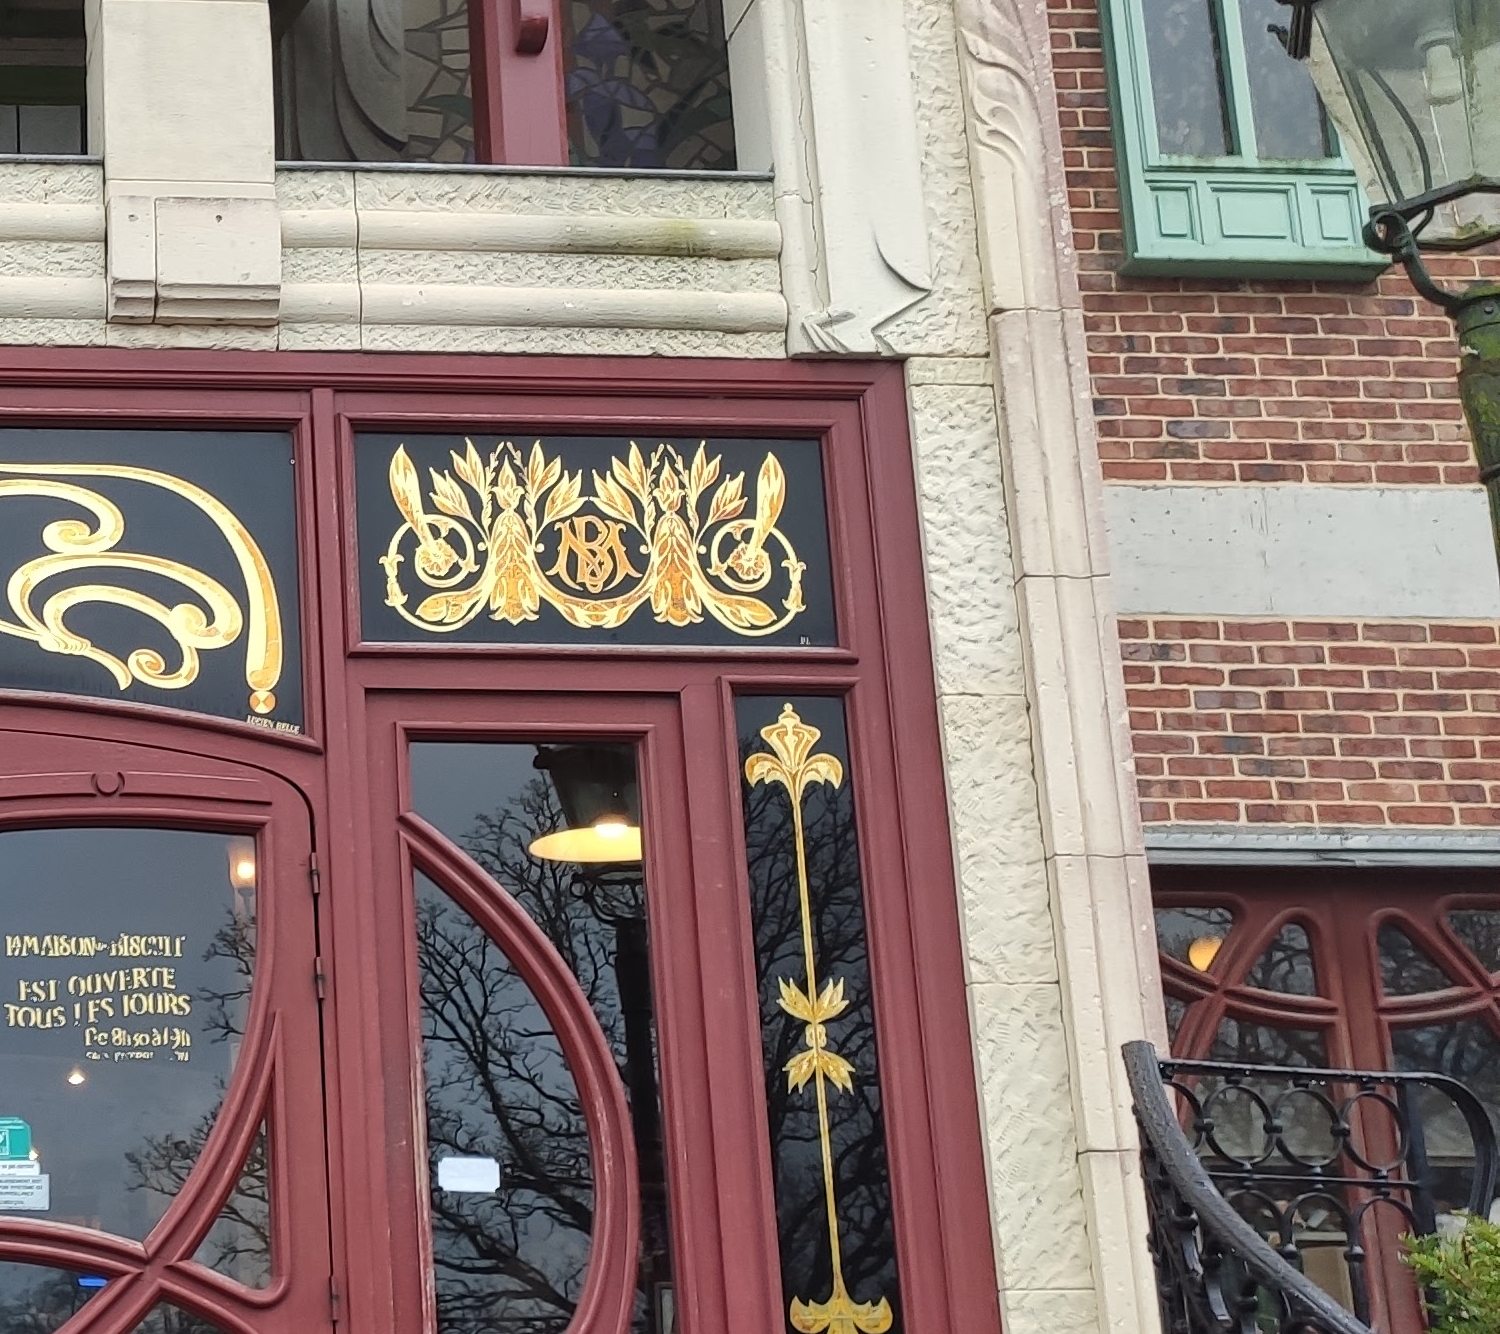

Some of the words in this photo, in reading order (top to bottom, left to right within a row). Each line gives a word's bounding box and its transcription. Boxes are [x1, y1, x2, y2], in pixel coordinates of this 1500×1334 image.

[19, 979, 61, 1003] EST
[67, 967, 177, 997] OUVERTE
[3, 1003, 67, 1029] TOUS
